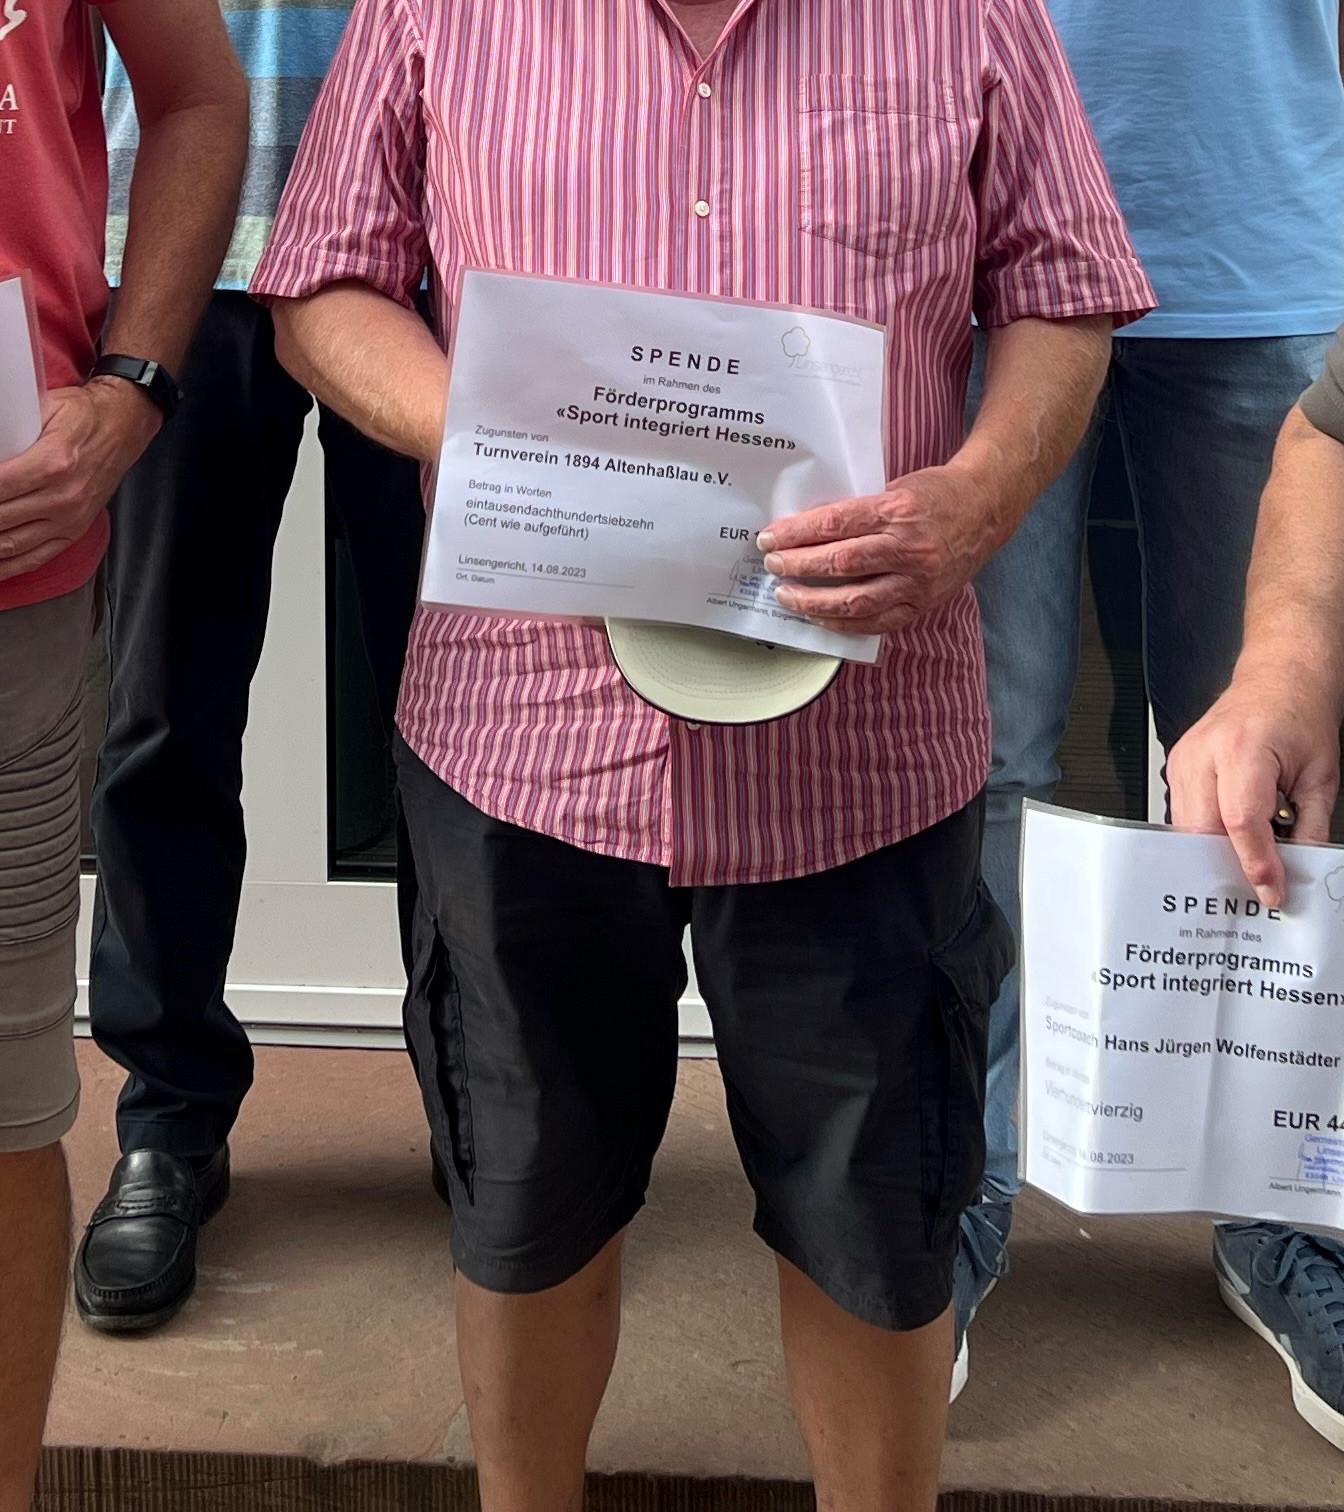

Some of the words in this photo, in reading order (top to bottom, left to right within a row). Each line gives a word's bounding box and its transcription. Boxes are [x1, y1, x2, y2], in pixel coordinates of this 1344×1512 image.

[631, 346, 741, 375] SPENDE
[643, 375, 655, 385] im
[658, 377, 700, 392] Rahmen
[702, 382, 721, 395] des
[593, 386, 765, 425] Förderprogramms
[475, 425, 528, 439] Zugunsten
[531, 433, 548, 442] von
[556, 404, 619, 430] «Sport
[623, 413, 711, 442] integriert
[716, 426, 797, 452] Hessen»
[474, 442, 558, 465] Turnverein
[564, 453, 600, 469] 1894
[604, 456, 698, 484] Altenhaßlau
[703, 471, 733, 487] e.V.
[468, 479, 502, 494] Betrag
[504, 483, 513, 493] in
[516, 485, 552, 498] Worten
[464, 513, 497, 528] (Cent
[501, 518, 521, 530] wie
[524, 521, 589, 541] aufgeführt)
[466, 498, 655, 531] eintausendachthundertsiebzehn
[719, 526, 749, 541] EUR
[458, 554, 528, 572] Linsengericht,
[532, 563, 587, 578] 14.08.2023
[1162, 894, 1283, 921] SPENDE
[1179, 928, 1192, 939] im
[1195, 928, 1238, 941] Rahmen
[1242, 931, 1262, 943] des
[1125, 943, 1314, 979] Förderprogramms
[1162, 973, 1254, 996] integriert
[1105, 1034, 1149, 1053] Hans
[1154, 1035, 1211, 1057] Jürgen
[1216, 1037, 1341, 1068] Wolfenstädter
[1274, 1110, 1320, 1131] EUR
